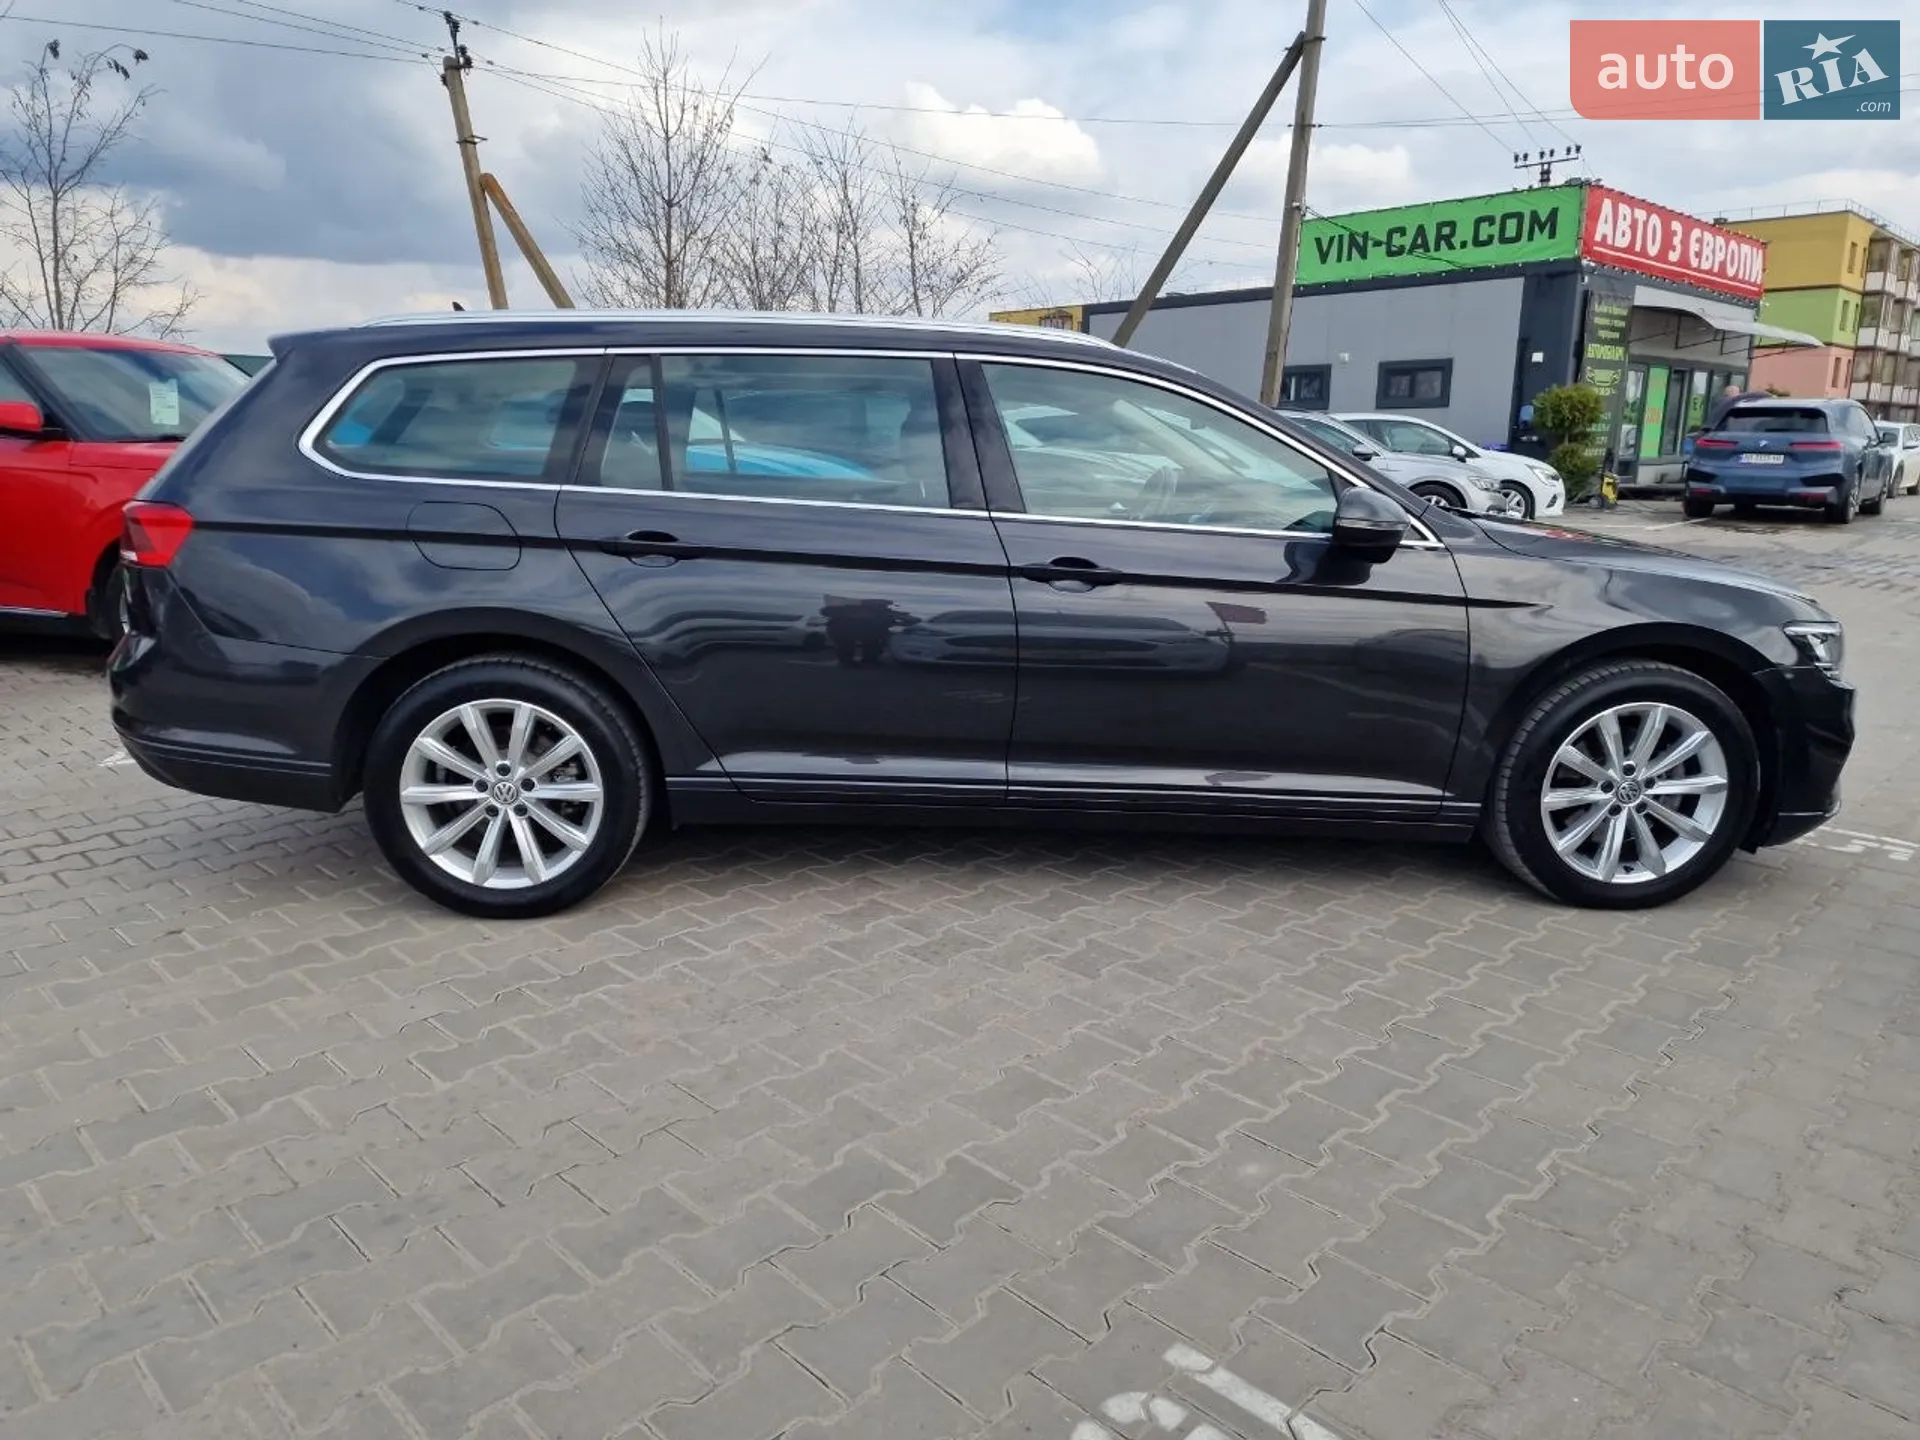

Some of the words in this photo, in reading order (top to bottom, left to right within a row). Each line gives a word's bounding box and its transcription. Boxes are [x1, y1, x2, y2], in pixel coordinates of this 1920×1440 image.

[1314, 207, 1560, 265] VIN-CAR.COM
[1594, 197, 1662, 257] АВТО
[1688, 227, 1764, 285] ЄВРОПИ
